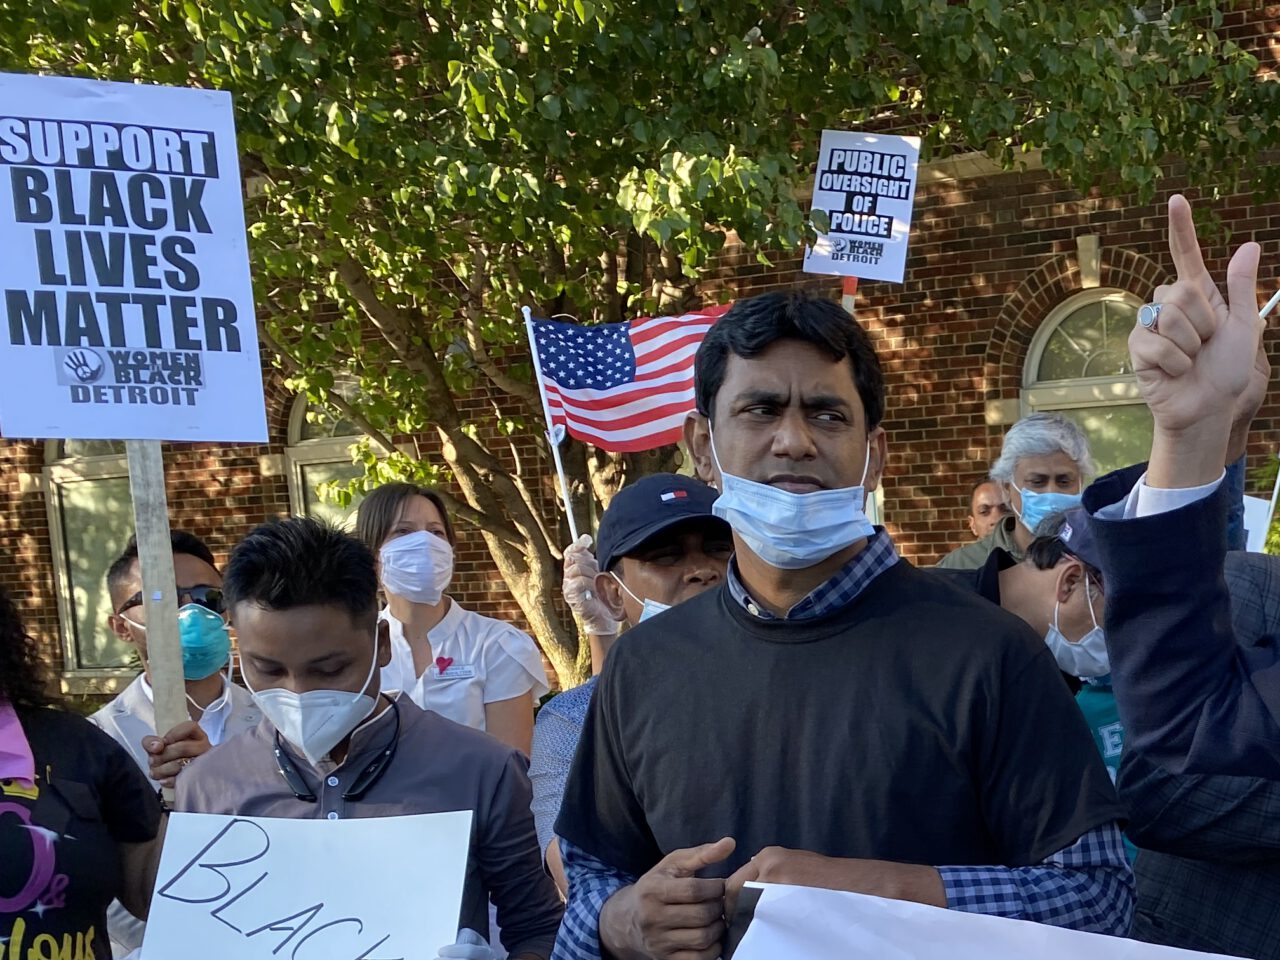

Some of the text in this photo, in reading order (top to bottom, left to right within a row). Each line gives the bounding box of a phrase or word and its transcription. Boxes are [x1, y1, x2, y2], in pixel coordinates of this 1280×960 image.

[0, 117, 209, 175] SUPPORT
[830, 150, 906, 178] PUBLIC
[820, 173, 910, 199] OVERSIGHT
[10, 166, 213, 234] BLACK
[851, 195, 873, 213] OF
[830, 212, 889, 236] POLICE
[34, 228, 200, 292] LIVES
[831, 252, 881, 265] DETROIT
[4, 289, 242, 353] MATTER
[107, 350, 201, 369] WOMEN
[114, 367, 203, 385] BLACK
[70, 384, 199, 406] DETROIT
